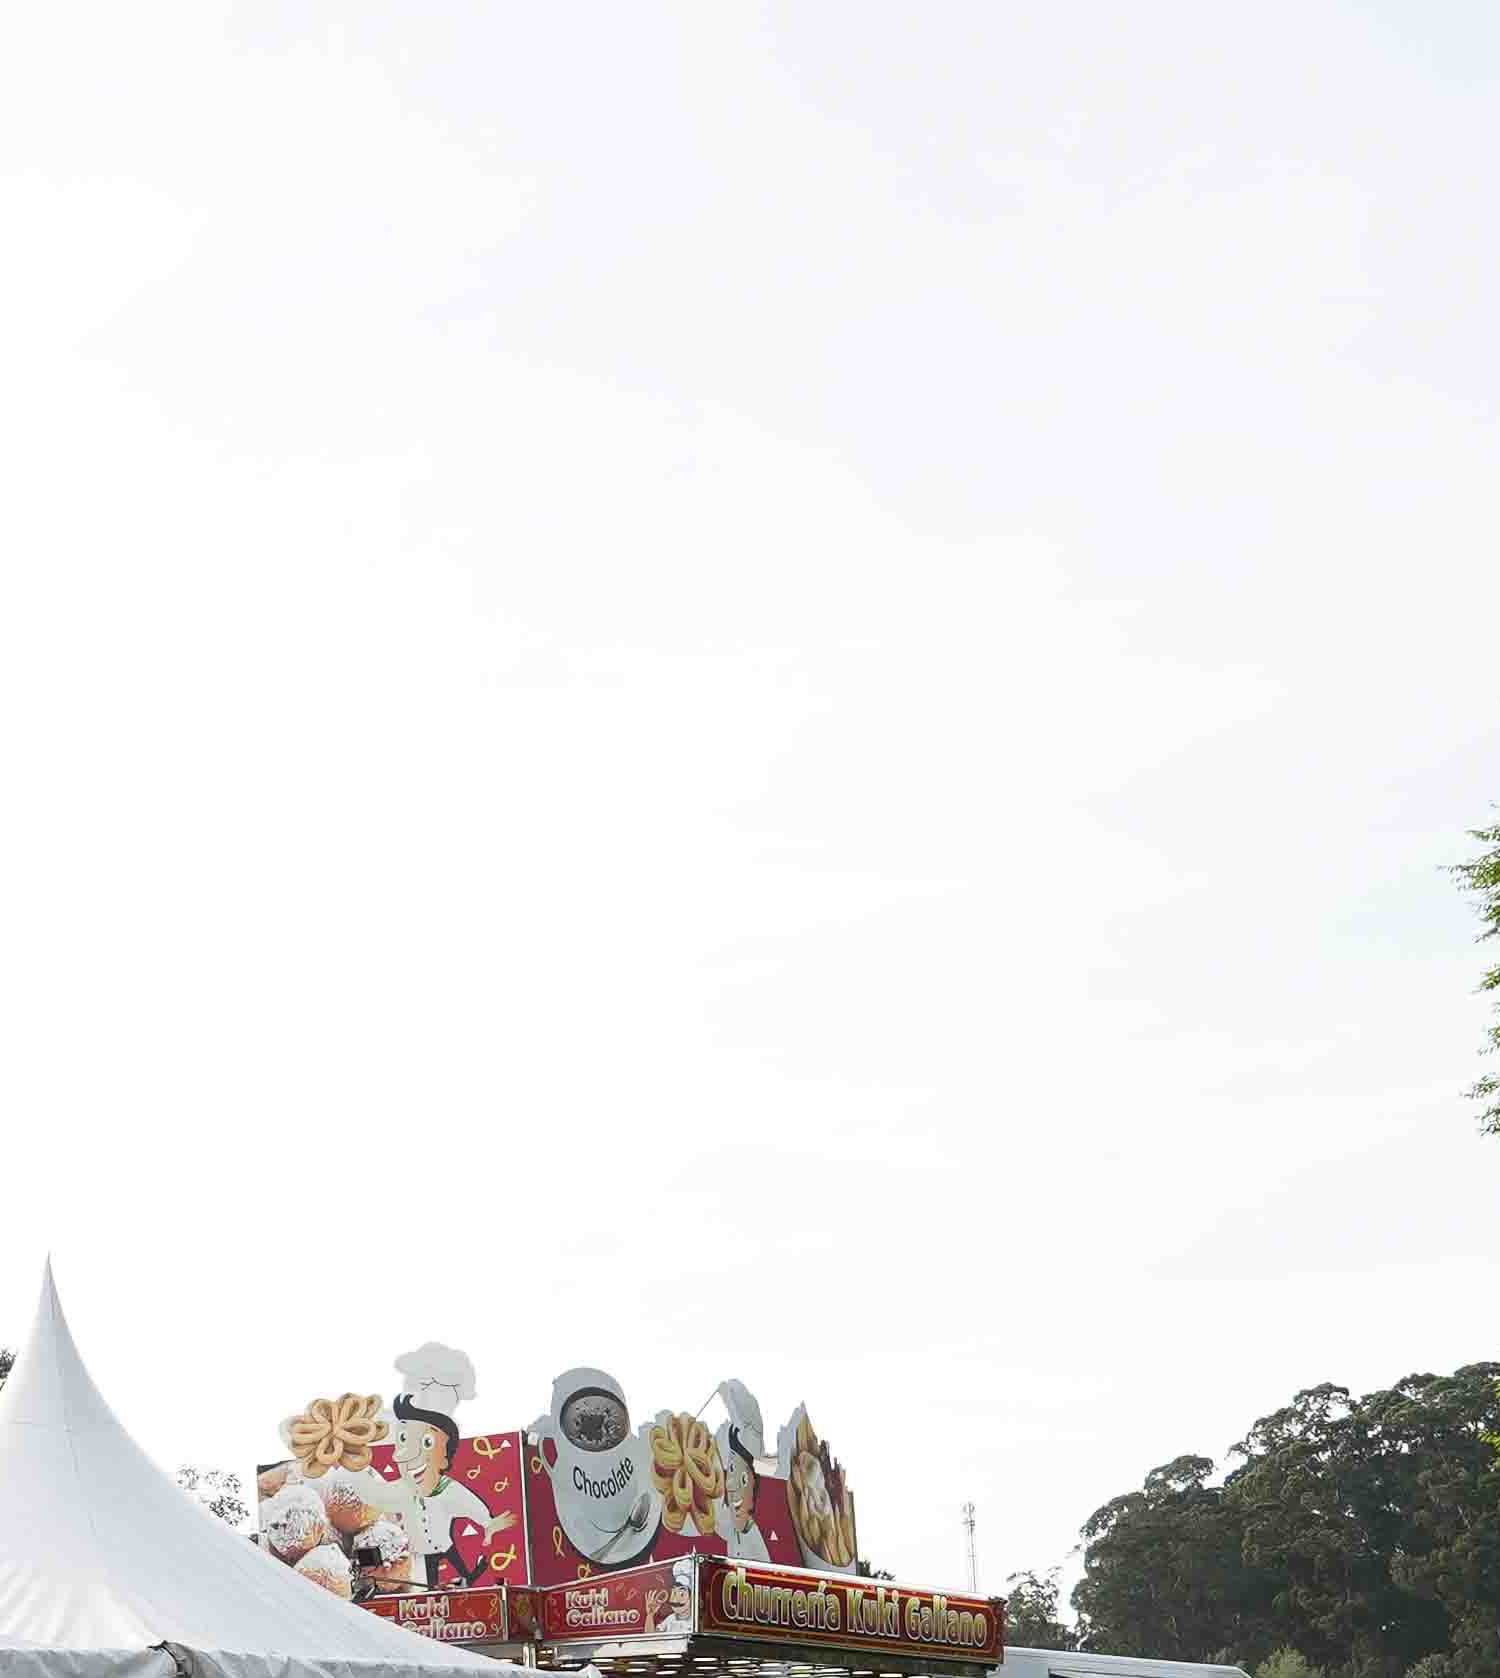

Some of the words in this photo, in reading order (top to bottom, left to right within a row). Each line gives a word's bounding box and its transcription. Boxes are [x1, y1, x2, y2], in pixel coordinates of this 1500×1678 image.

[572, 1457, 634, 1499] Chocolate
[399, 1595, 450, 1620] Kuki
[565, 1587, 609, 1610] Kuki
[722, 1567, 841, 1632] Churrería
[847, 1586, 901, 1639] Kuki
[905, 1595, 988, 1647] Galiano
[566, 1605, 641, 1628] Galiano
